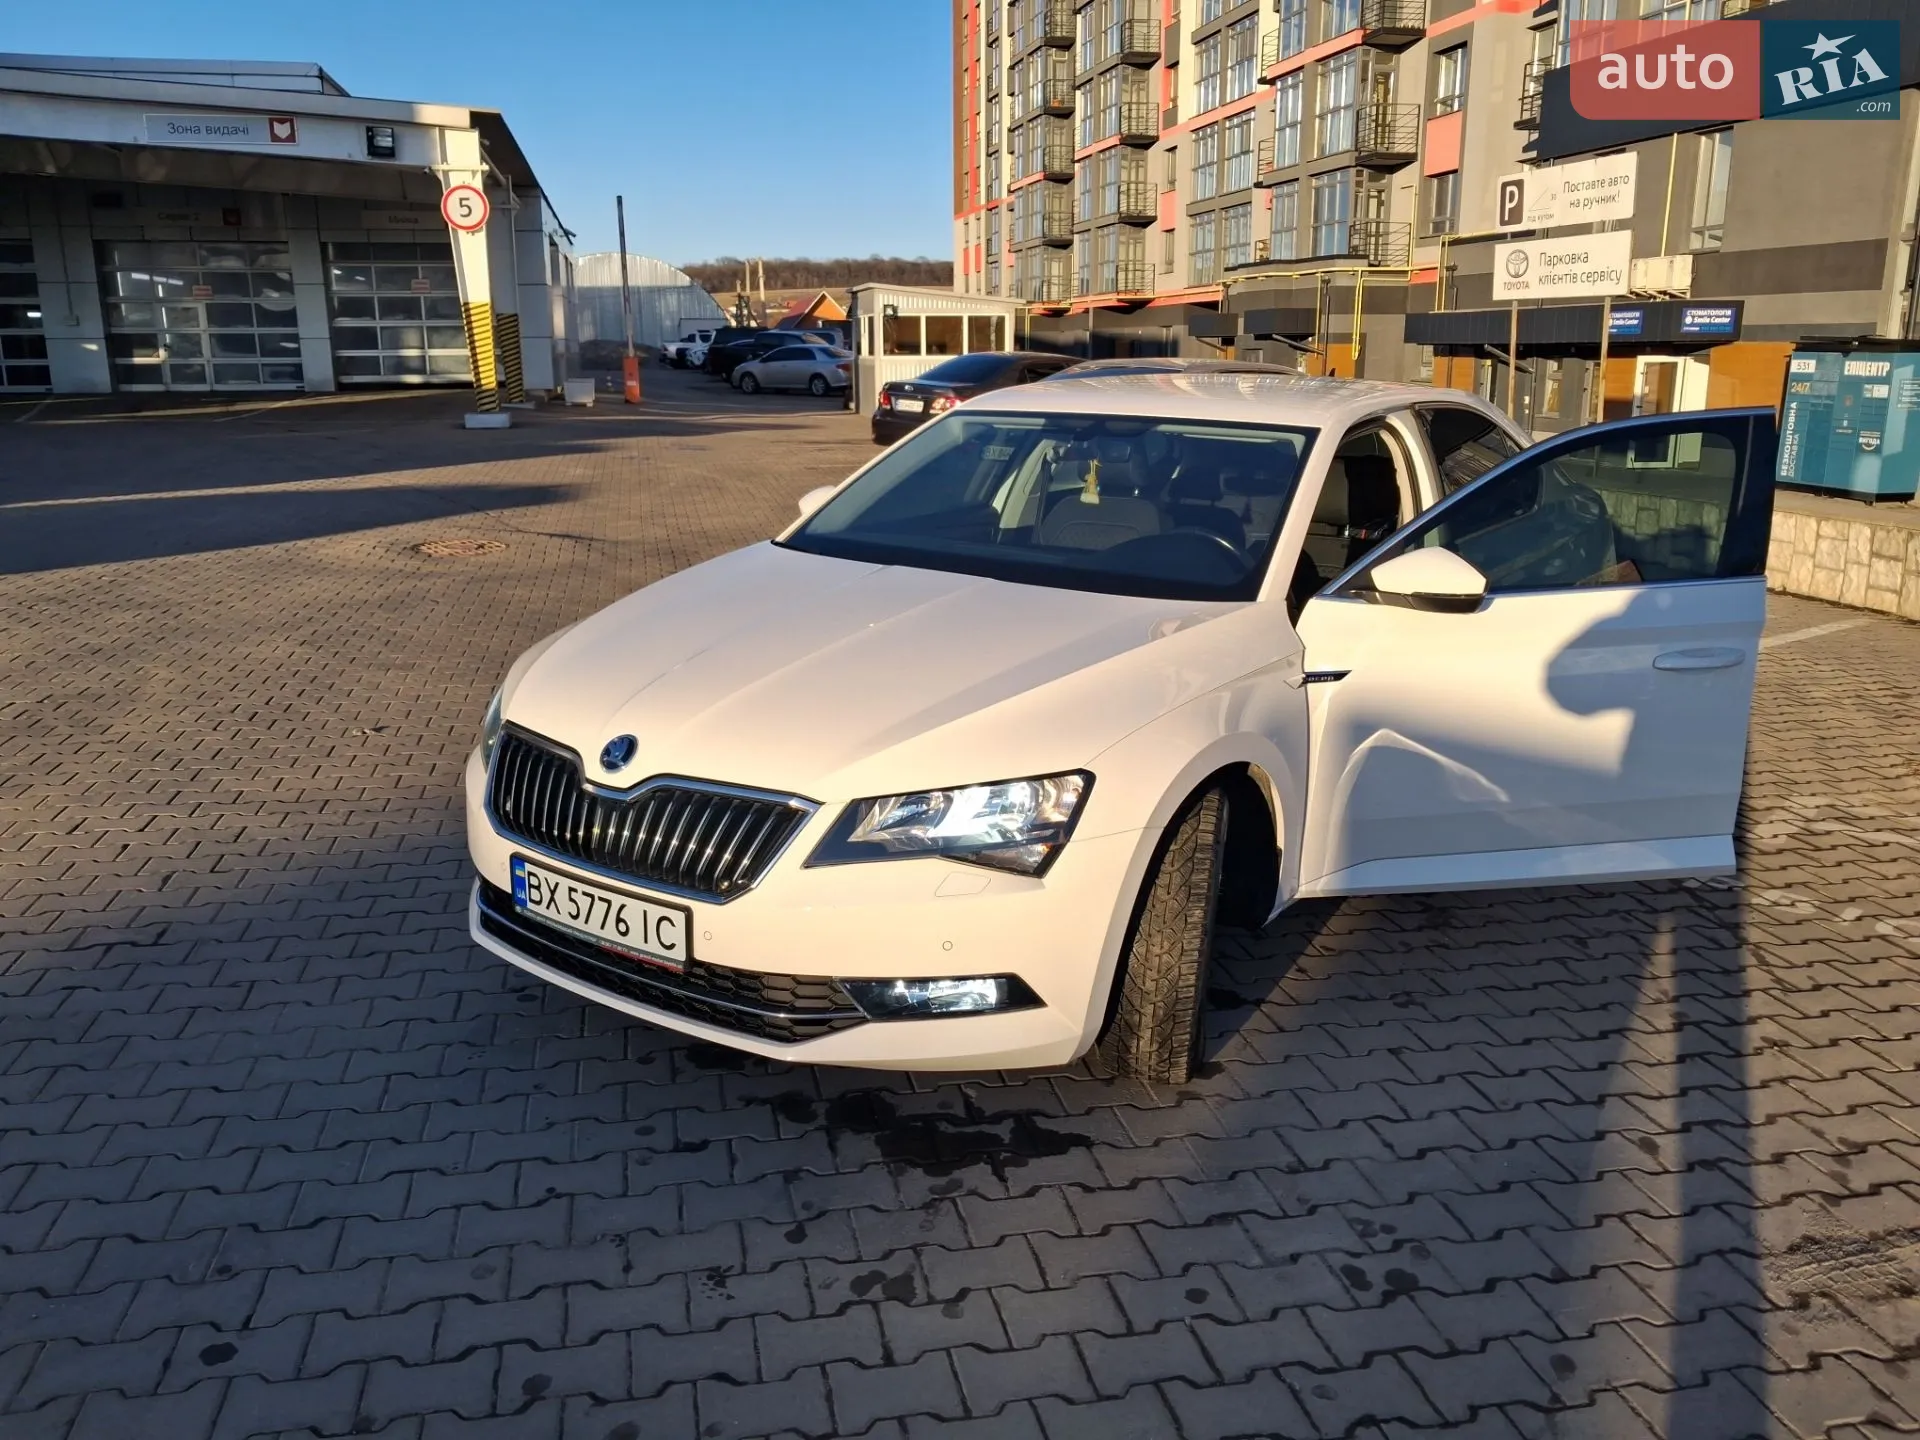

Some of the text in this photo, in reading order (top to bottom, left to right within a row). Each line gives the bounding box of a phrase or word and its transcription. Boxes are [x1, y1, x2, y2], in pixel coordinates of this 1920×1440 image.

[167, 122, 249, 137] Зона видачі
[1562, 174, 1630, 194] Поставте авто
[459, 197, 472, 218] 5
[1504, 185, 1519, 221] P
[1569, 190, 1621, 211] на ручник!
[1539, 251, 1589, 269] Парковка
[1503, 281, 1530, 291] TOYOTA
[1538, 266, 1623, 287] клієнтів сервісу
[1796, 362, 1810, 370] 531
[1843, 360, 1891, 377] ЕПІЦЕНТР
[1790, 382, 1811, 393] 24/7
[1780, 401, 1797, 477] БЕЗКОШТОВНА
[1788, 433, 1800, 478] ДОСТАВКА
[516, 887, 526, 900] UA
[526, 870, 562, 915] BX
[567, 885, 631, 938] 5776
[642, 908, 678, 951] IC
